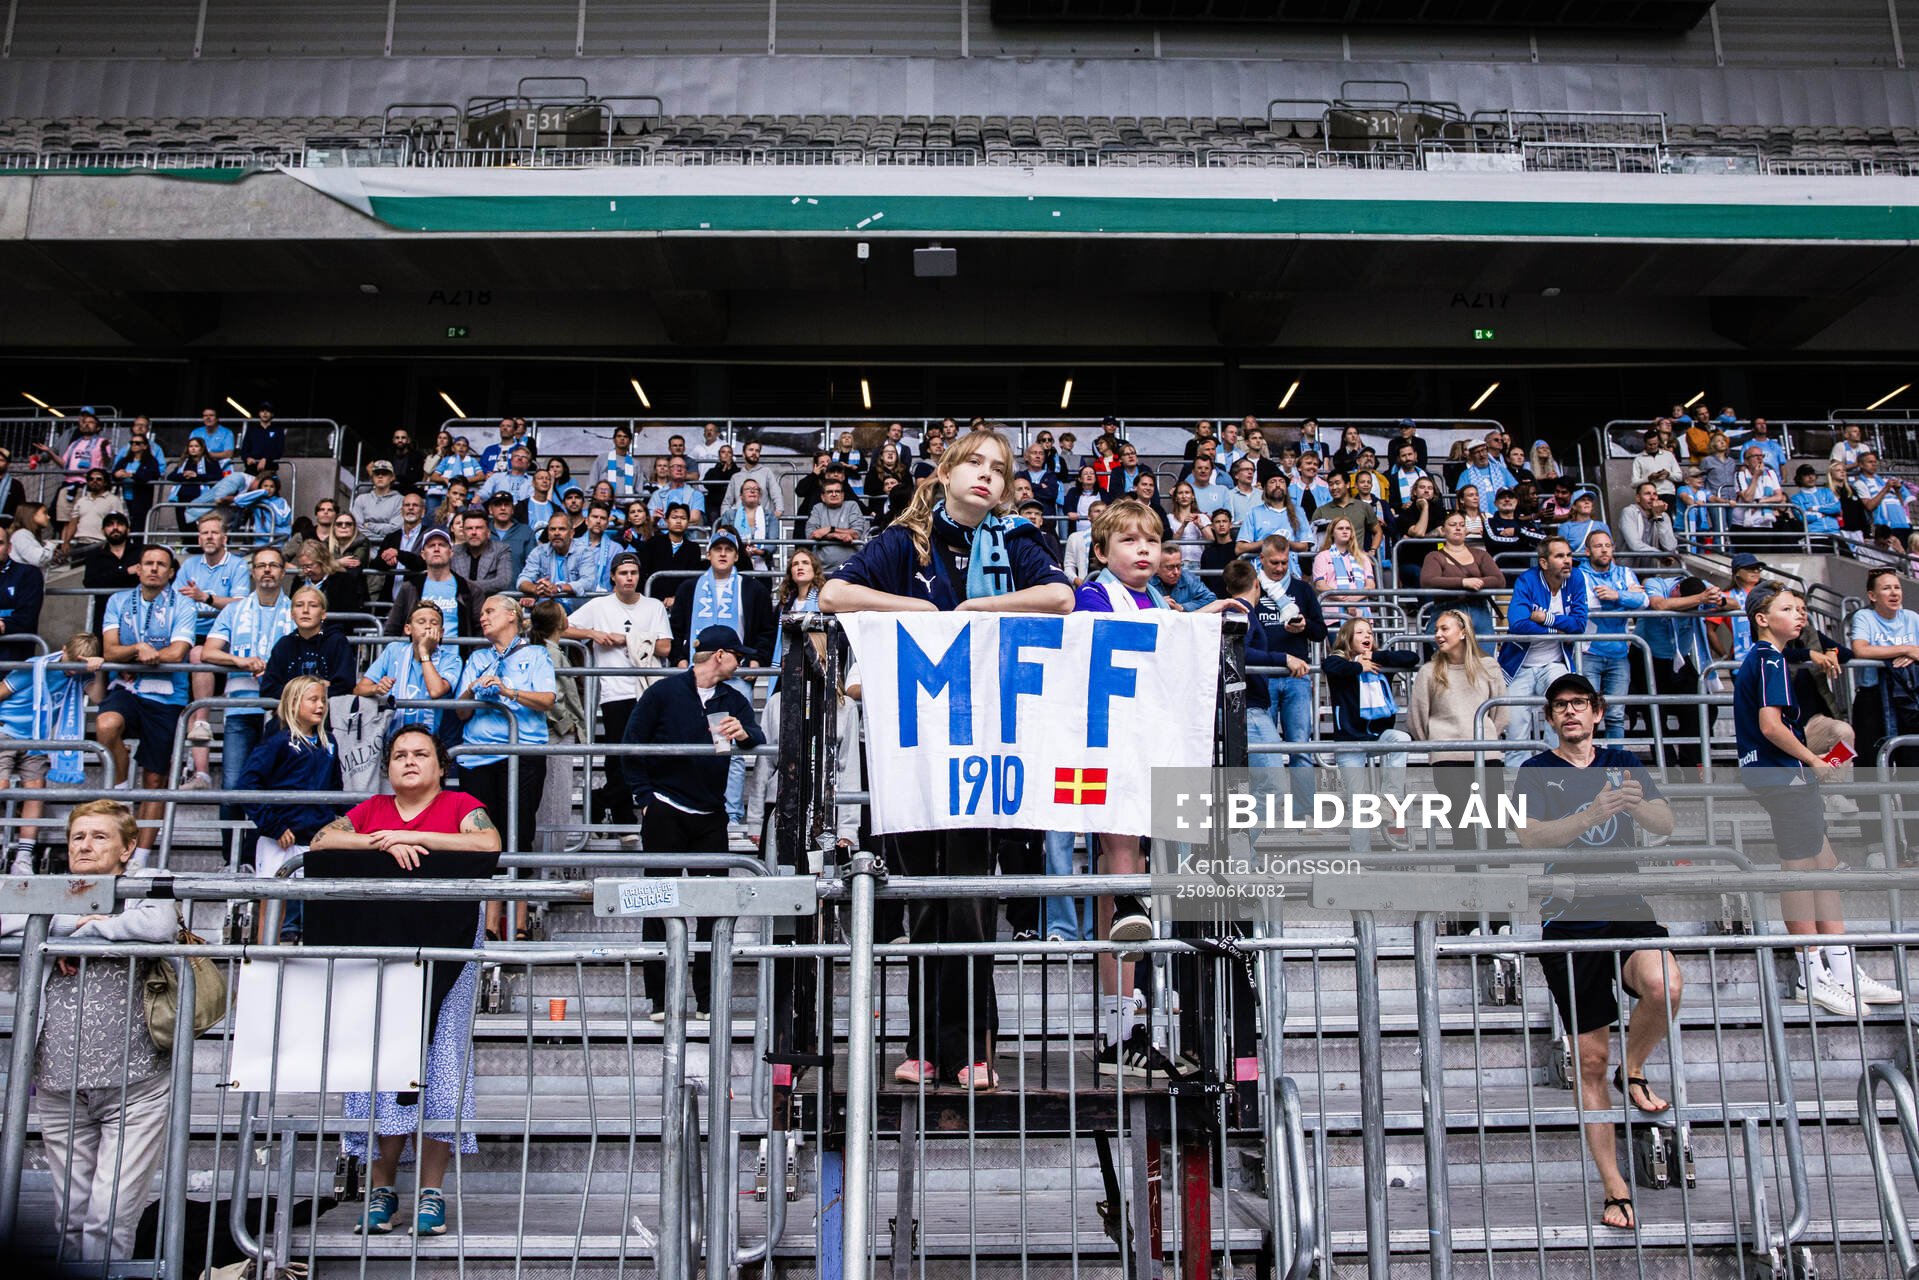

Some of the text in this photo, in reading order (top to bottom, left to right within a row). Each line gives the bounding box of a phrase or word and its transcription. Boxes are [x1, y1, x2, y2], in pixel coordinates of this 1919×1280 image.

[896, 616, 1159, 748] MFF
[949, 754, 1024, 816] 1910
[623, 892, 672, 909] ULTRAS
